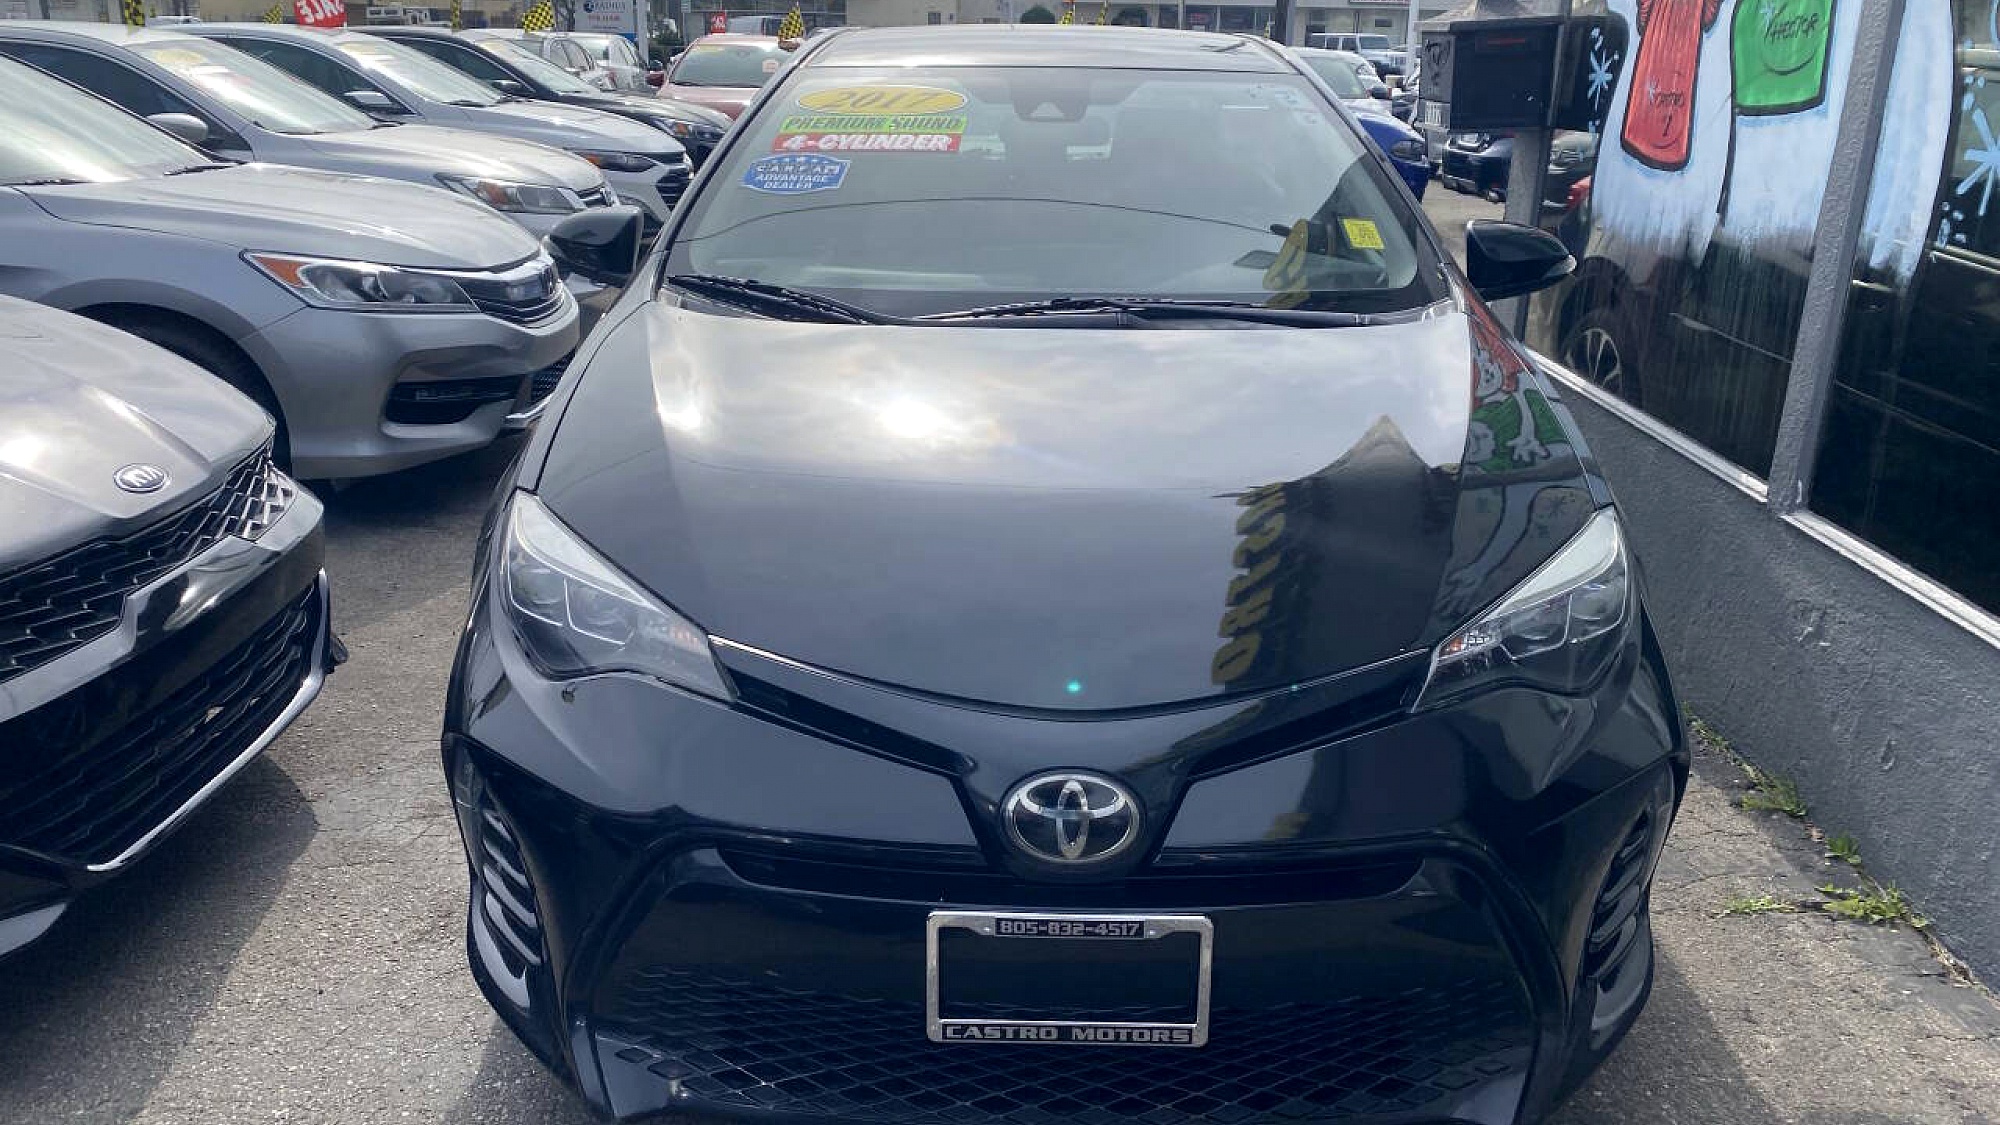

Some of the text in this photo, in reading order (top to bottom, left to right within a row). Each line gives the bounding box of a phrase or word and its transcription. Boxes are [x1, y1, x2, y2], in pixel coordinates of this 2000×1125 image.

[822, 90, 940, 110] 2017
[785, 116, 963, 130] PREMIUM SOUND
[782, 134, 953, 151] 4-CYLINDER
[755, 174, 829, 182] ADVANTAGE
[763, 181, 813, 189] DEALER
[999, 919, 1140, 937] 805-832-4517
[945, 1025, 1192, 1043] CASTRO MOTORS
